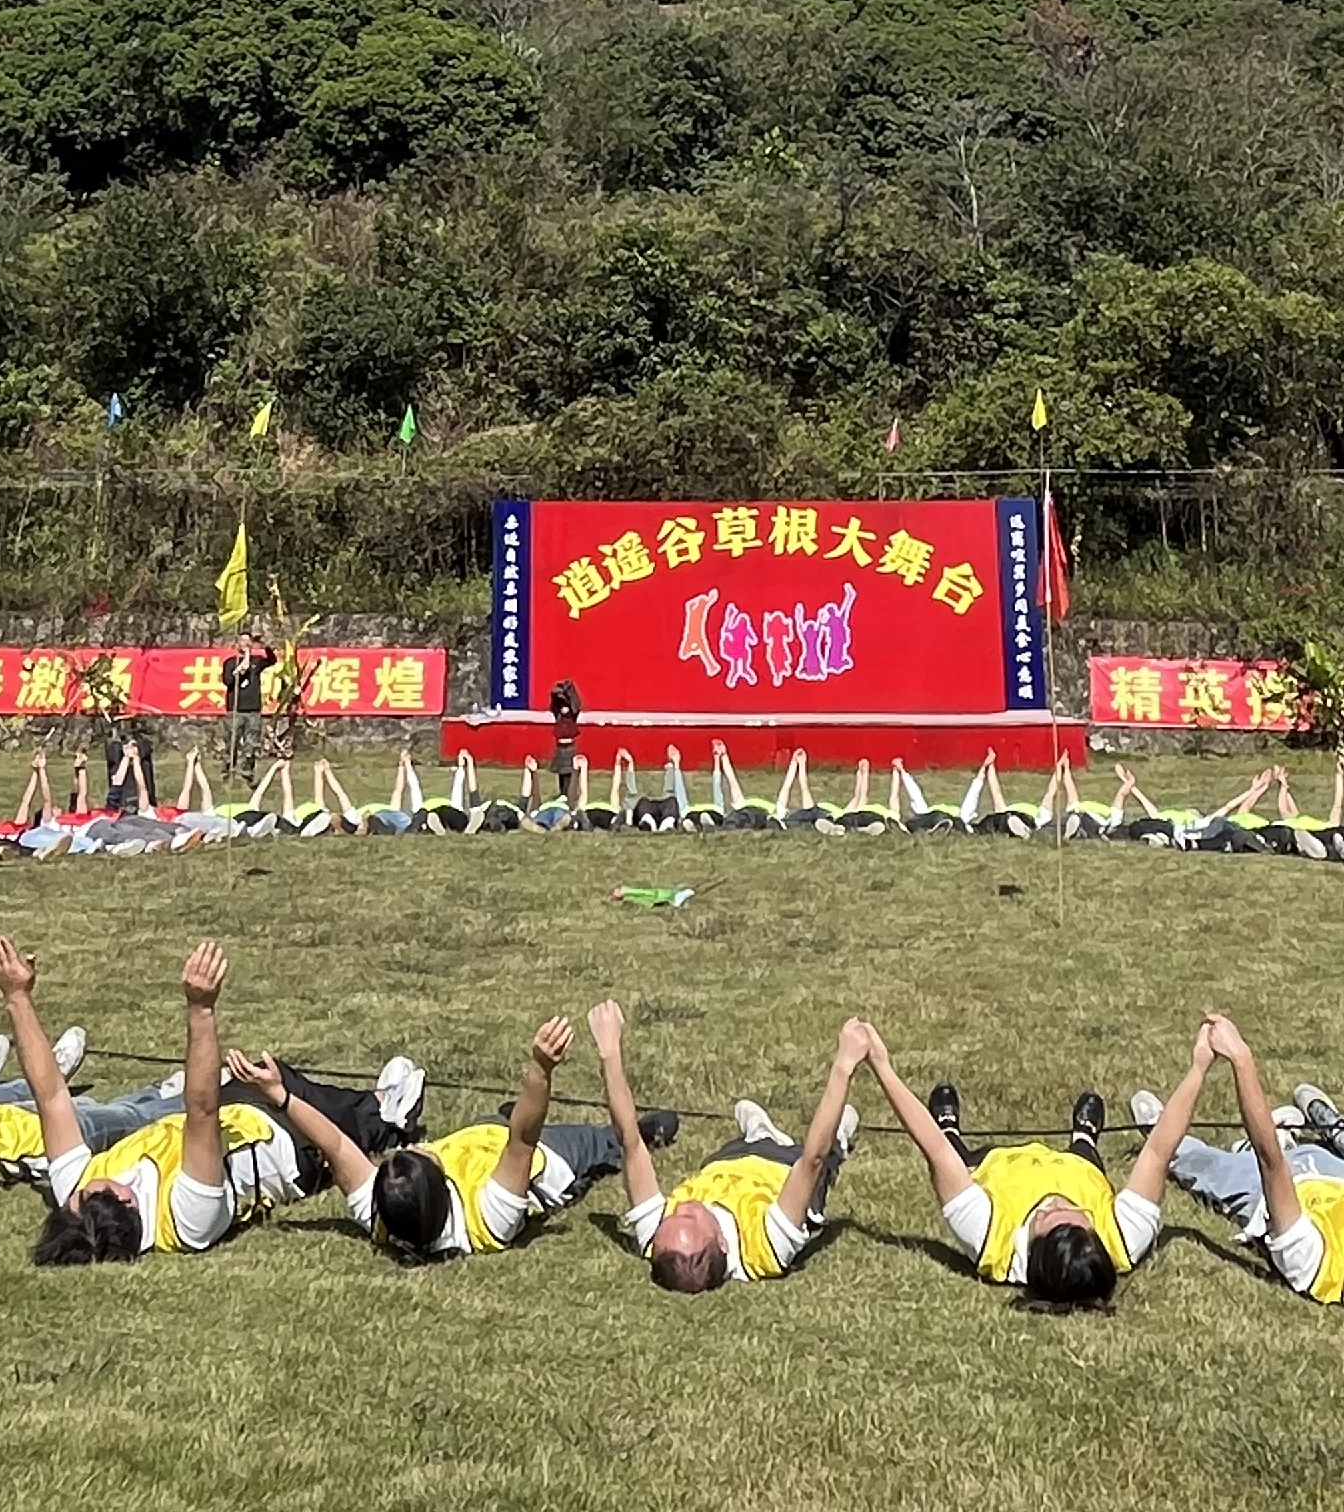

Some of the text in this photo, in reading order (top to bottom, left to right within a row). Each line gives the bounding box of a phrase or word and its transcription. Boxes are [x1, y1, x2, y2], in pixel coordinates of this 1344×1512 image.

[552, 504, 985, 620] 逍遥谷草根大舞台
